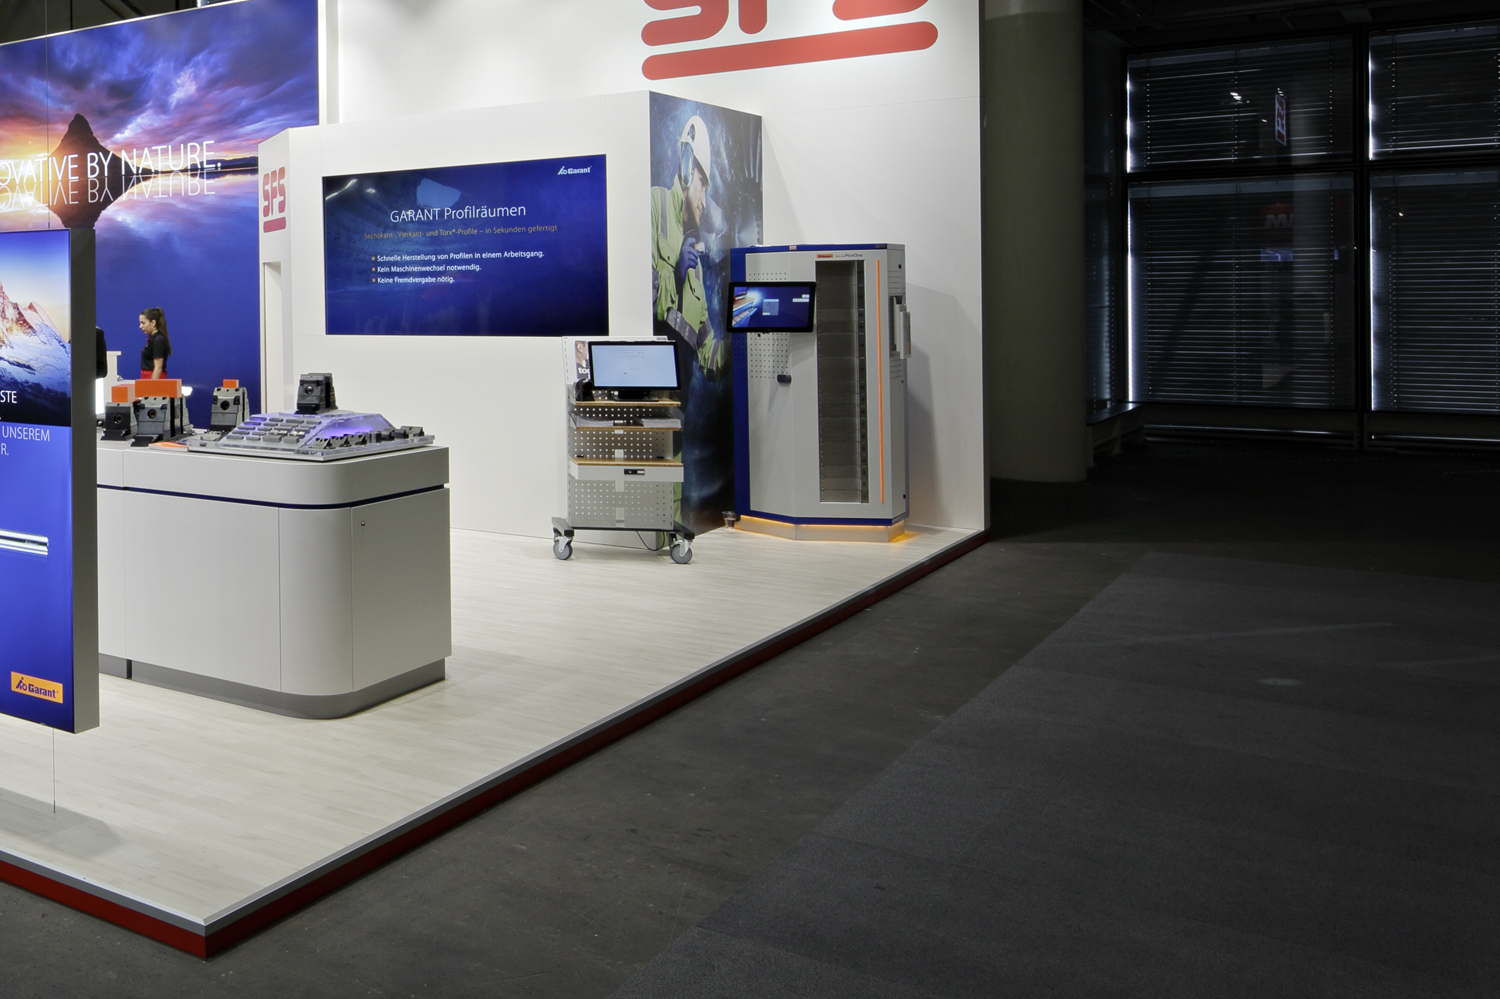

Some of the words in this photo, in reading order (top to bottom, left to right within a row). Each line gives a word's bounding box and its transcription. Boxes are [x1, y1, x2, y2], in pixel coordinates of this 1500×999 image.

[87, 152, 113, 179] BY
[121, 140, 222, 175] NATURE.
[568, 166, 591, 175] Garant
[263, 166, 285, 218] SFS
[390, 207, 441, 223] GARANT
[444, 205, 526, 220] Profilräumen
[493, 225, 526, 233] Sekunden
[527, 224, 558, 234] gefertigt
[402, 253, 436, 263] Herstellung
[449, 252, 474, 260] Profilen
[503, 250, 545, 259] Arbeitsgang.
[390, 264, 446, 273] Maschinenwechsel
[446, 264, 482, 272] notwendig.
[394, 276, 436, 285] Fremdvergabe
[437, 275, 455, 284] nötig.
[2, 425, 51, 442] UNSEREM
[28, 684, 57, 699] Garant
